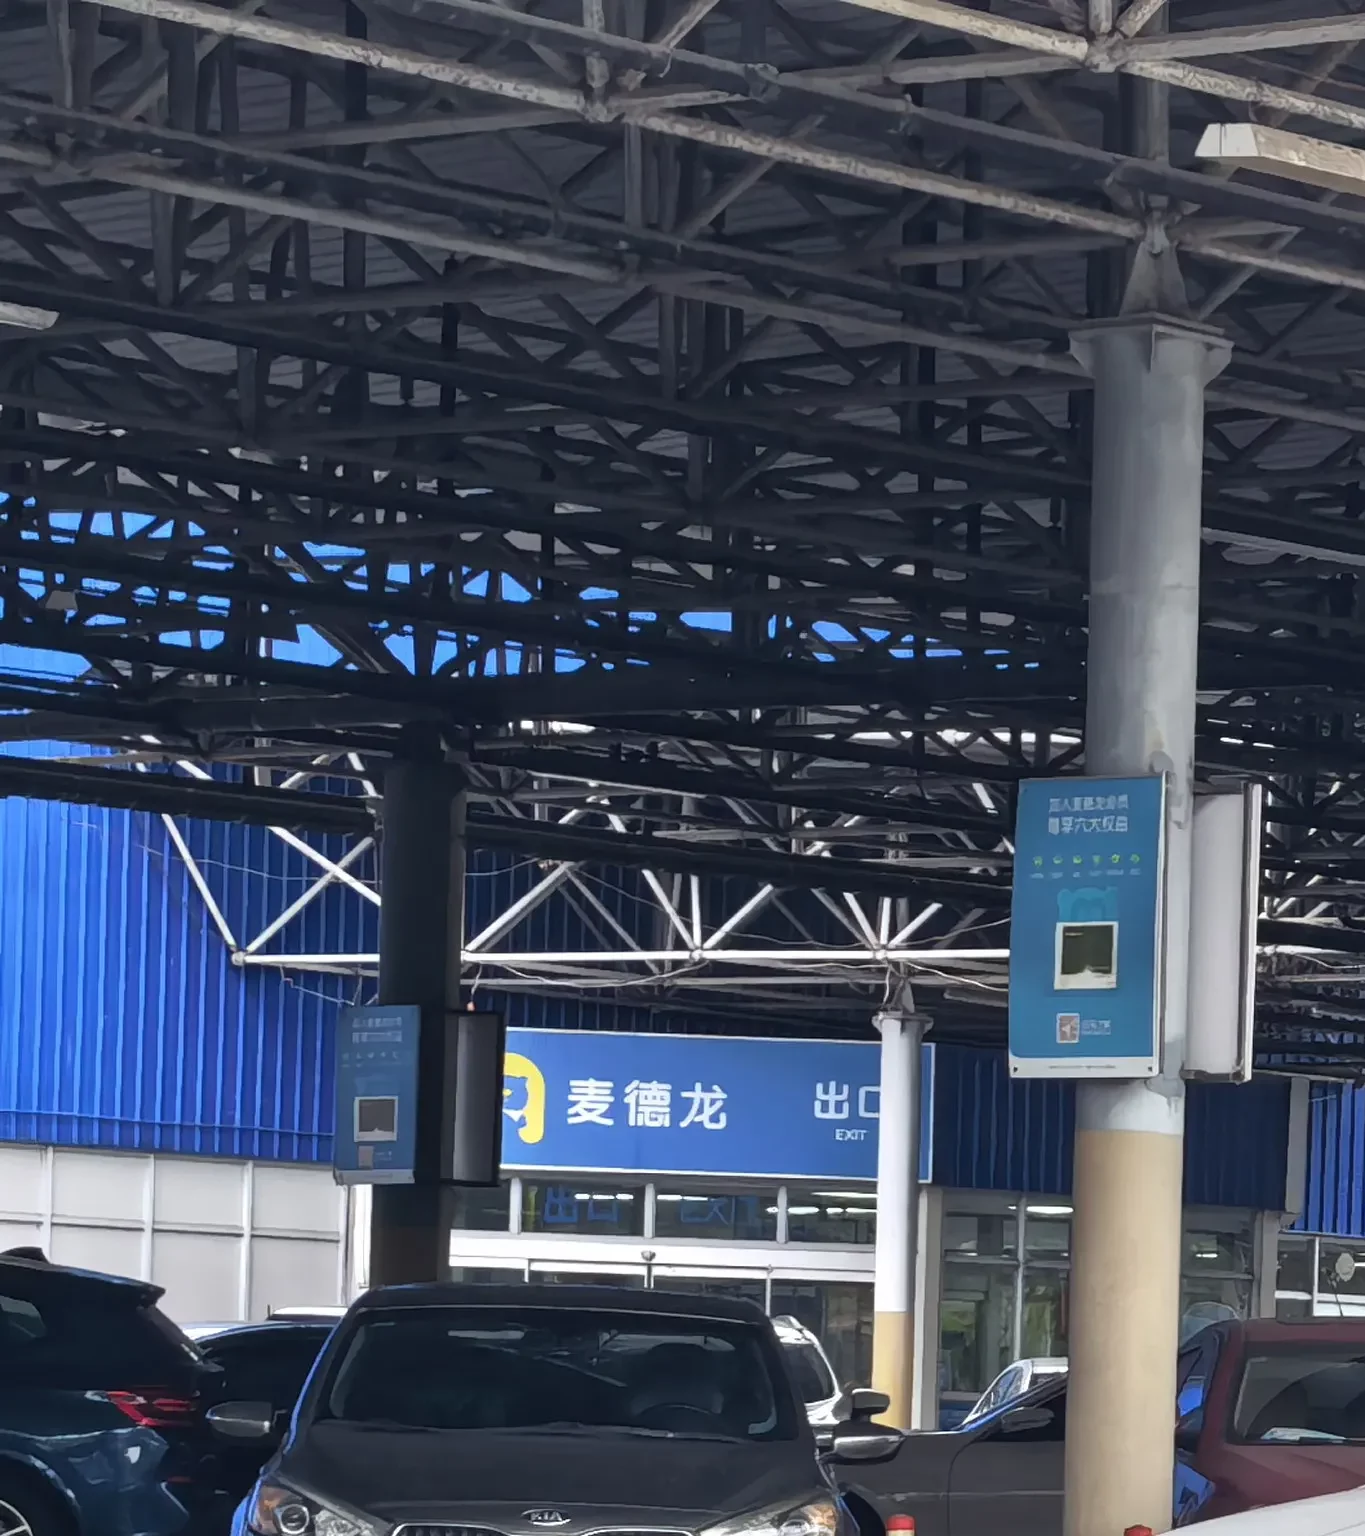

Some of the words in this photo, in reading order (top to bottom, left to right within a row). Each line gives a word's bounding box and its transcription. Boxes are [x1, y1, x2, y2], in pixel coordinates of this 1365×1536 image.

[566, 1077, 728, 1130] 麦德龙
[814, 1080, 881, 1120] 出口
[835, 1128, 868, 1141] EXIT
[530, 1511, 563, 1521] KIA
